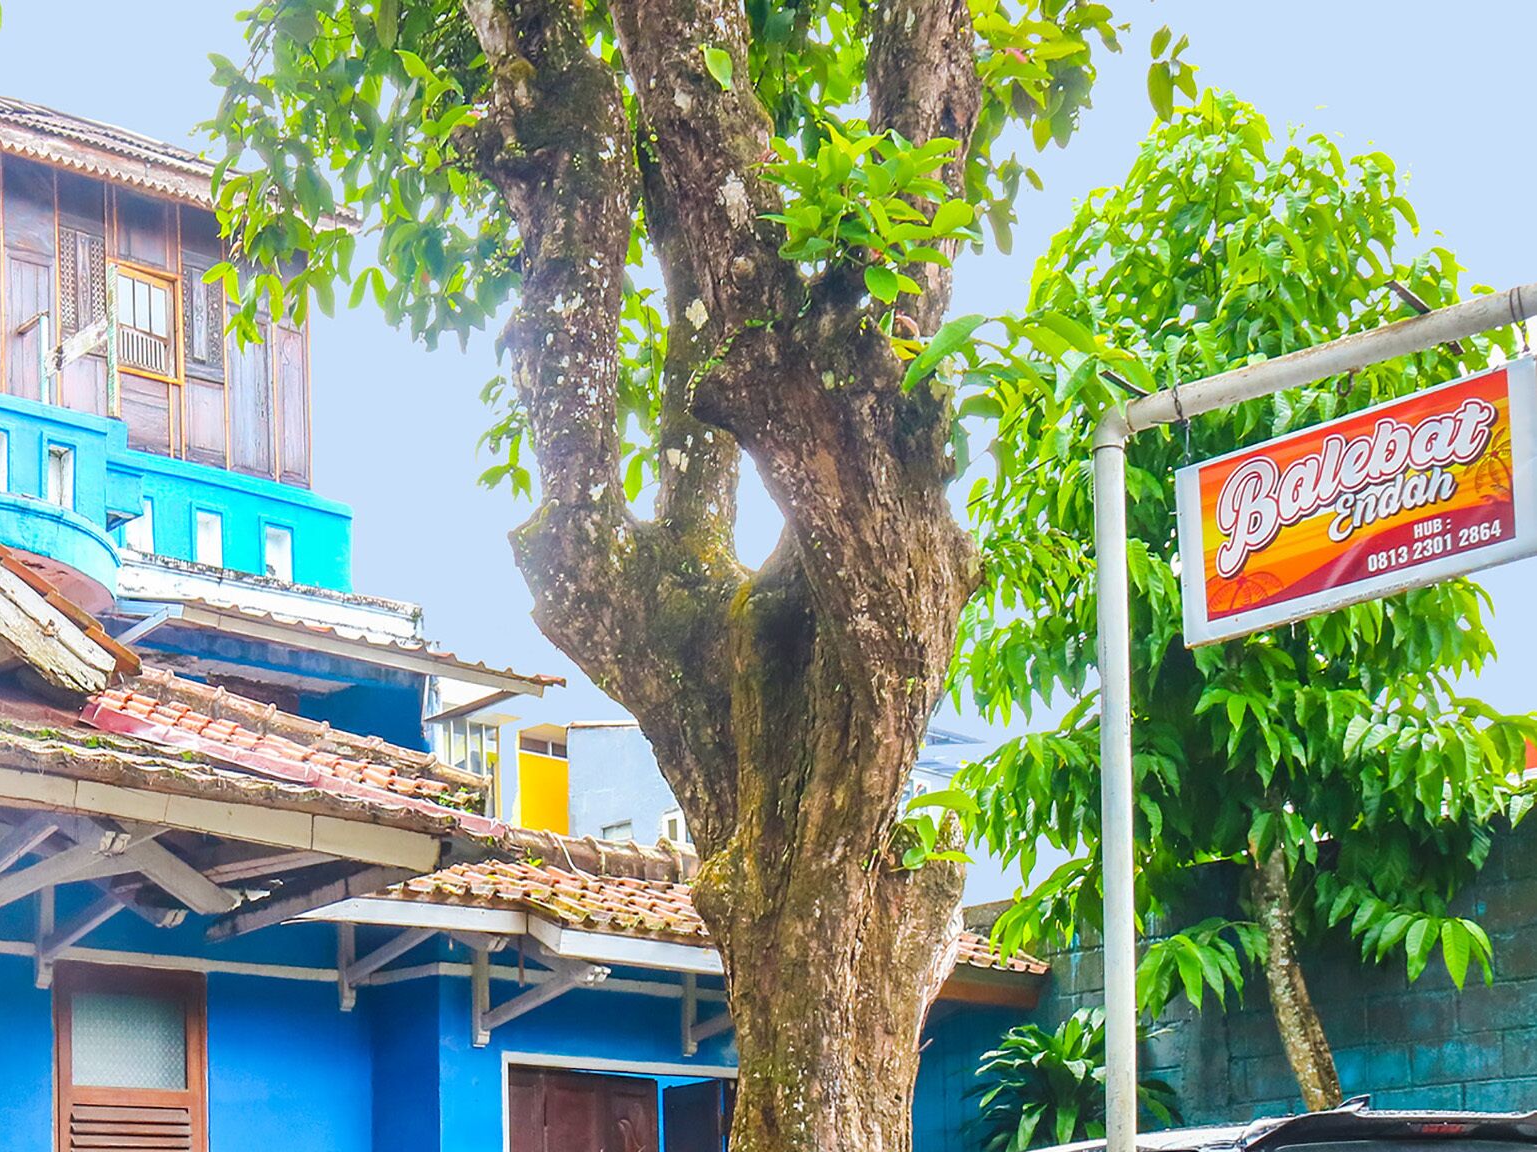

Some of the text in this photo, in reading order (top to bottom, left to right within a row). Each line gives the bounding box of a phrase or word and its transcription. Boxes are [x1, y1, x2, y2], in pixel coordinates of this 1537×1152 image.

[1216, 398, 1497, 579] Balebat
[1327, 466, 1458, 542] Endah
[1367, 519, 1502, 572] 0813 2301 2864
